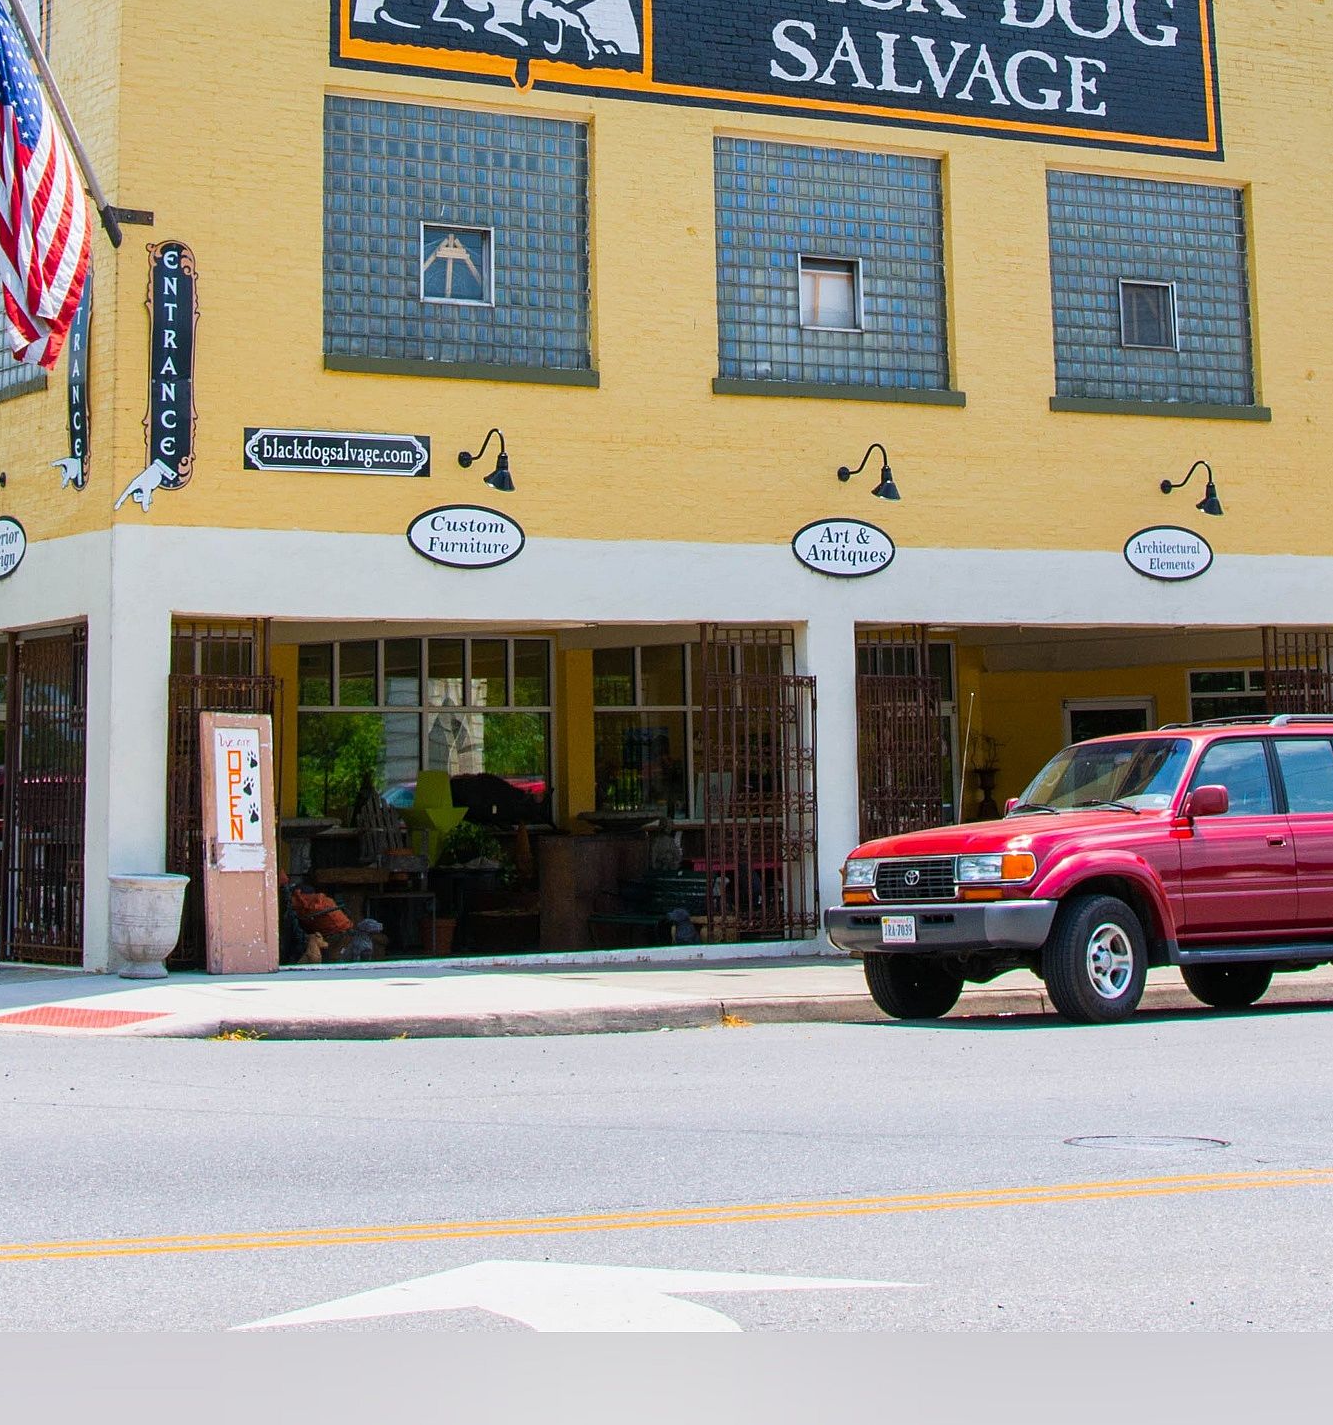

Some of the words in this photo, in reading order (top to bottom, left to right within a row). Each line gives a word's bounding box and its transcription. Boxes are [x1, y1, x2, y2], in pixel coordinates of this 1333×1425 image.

[769, 20, 1108, 117] SALVAGE
[158, 250, 180, 456] ENTRANCE
[262, 436, 414, 468] blackdogsalvage.com
[430, 515, 506, 534] Custom
[428, 536, 510, 555] Furniture
[819, 526, 850, 545] Art
[855, 528, 871, 545] &
[805, 544, 887, 566] Antiques
[1133, 540, 1201, 556] Architectural
[1148, 557, 1196, 571] Elements
[227, 750, 245, 842] OPEN
